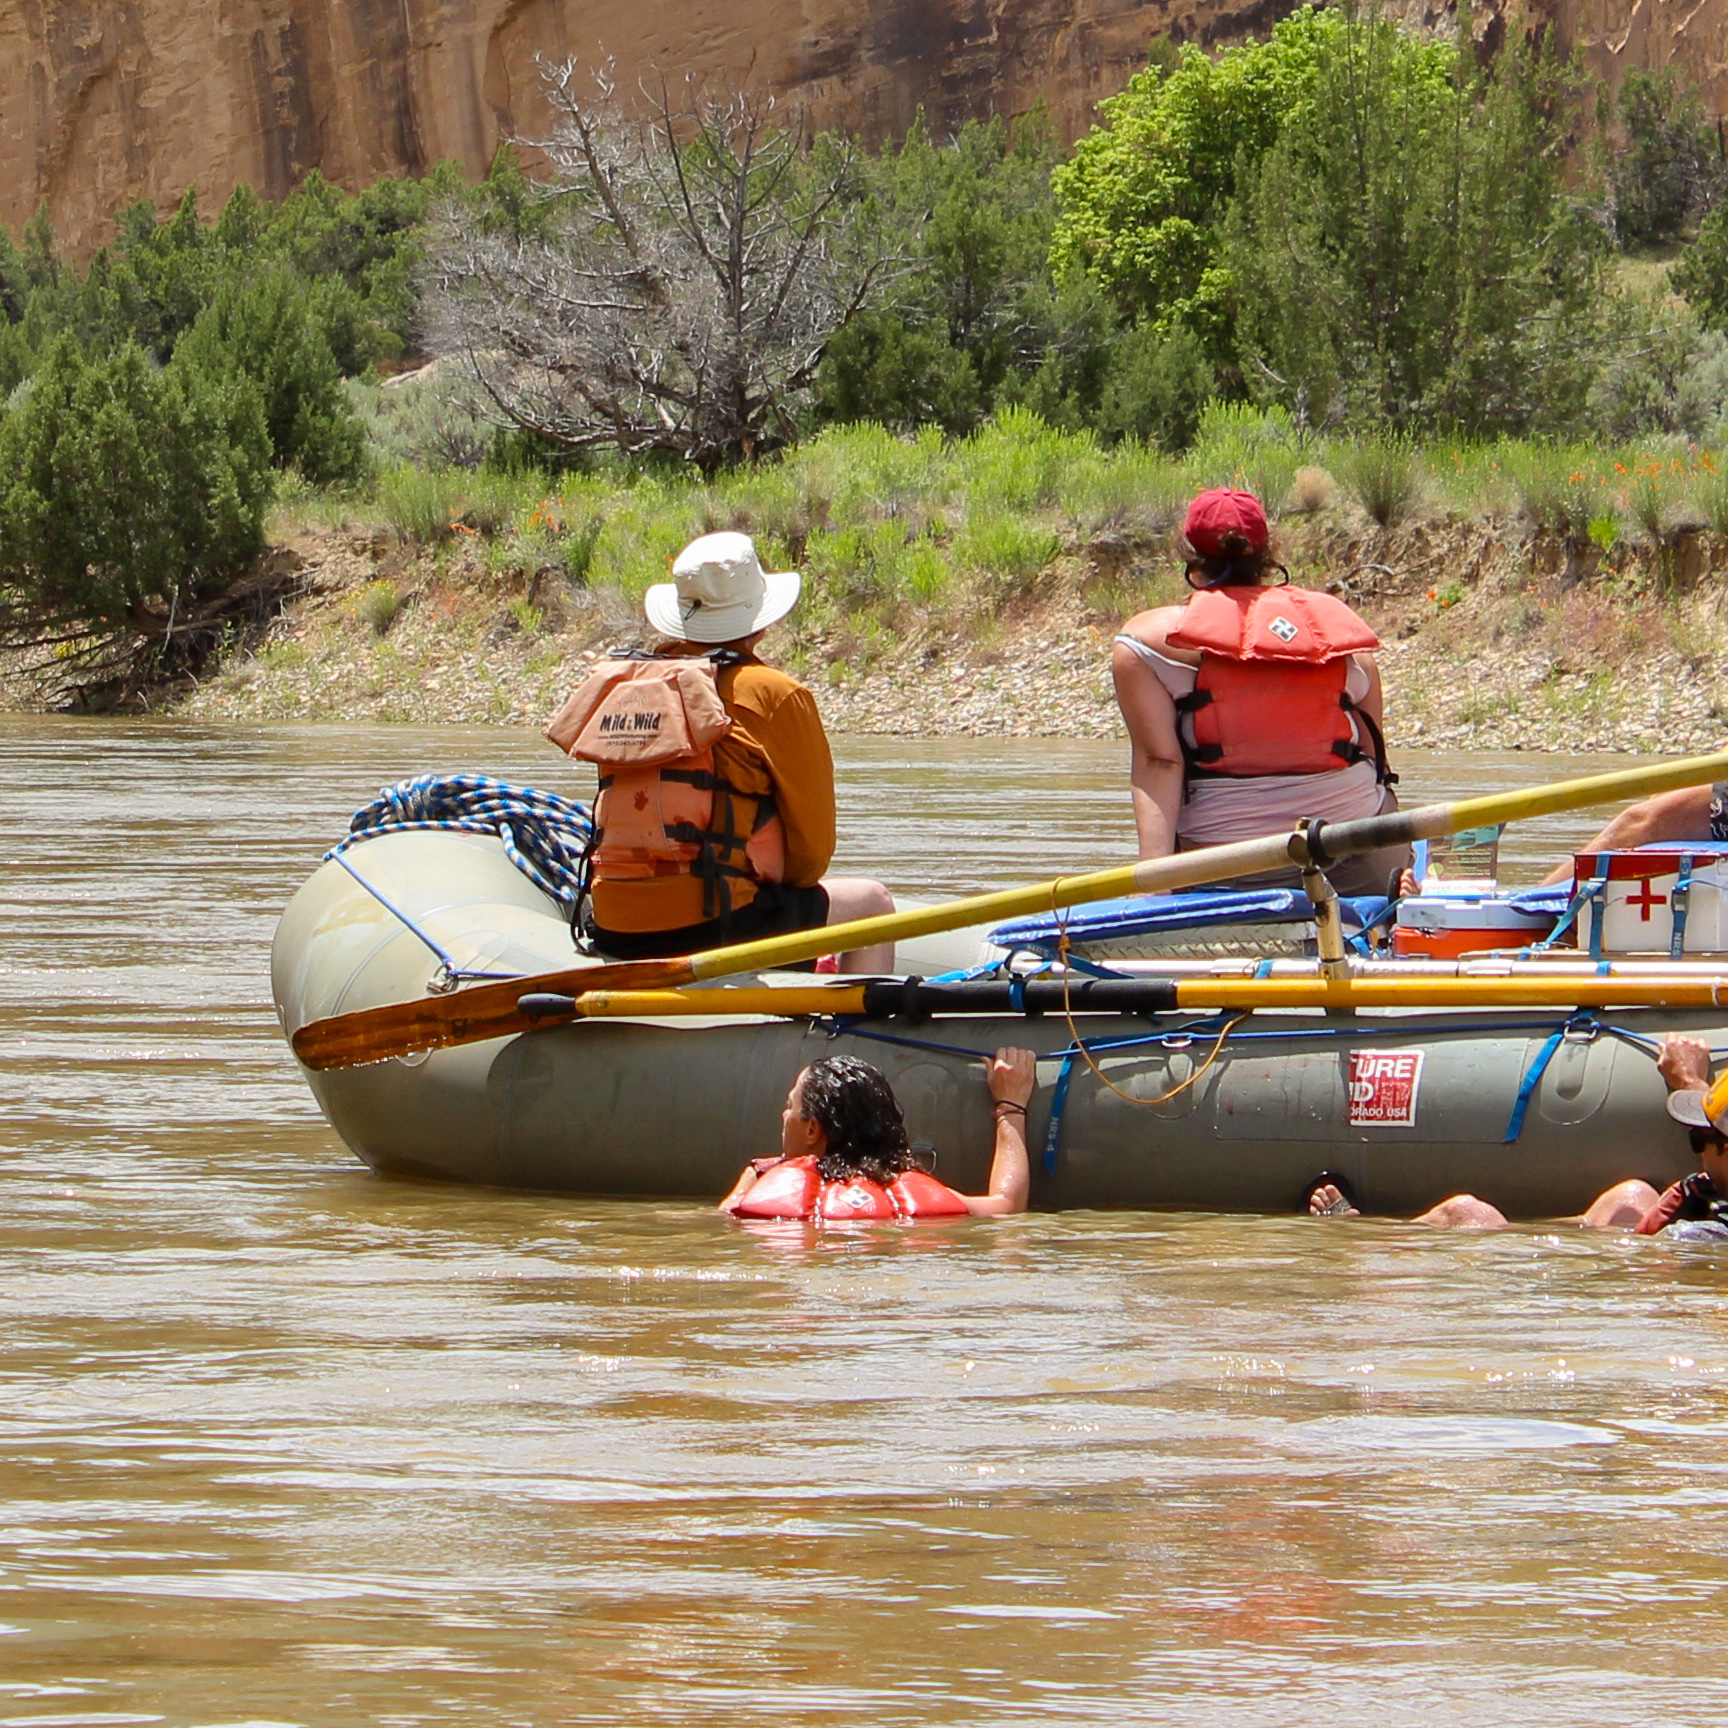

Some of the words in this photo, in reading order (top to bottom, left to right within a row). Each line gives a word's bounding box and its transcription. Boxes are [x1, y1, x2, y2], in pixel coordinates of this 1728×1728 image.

[600, 713, 628, 731] Mild
[634, 712, 661, 731] Wild
[1387, 1107, 1408, 1118] USA
